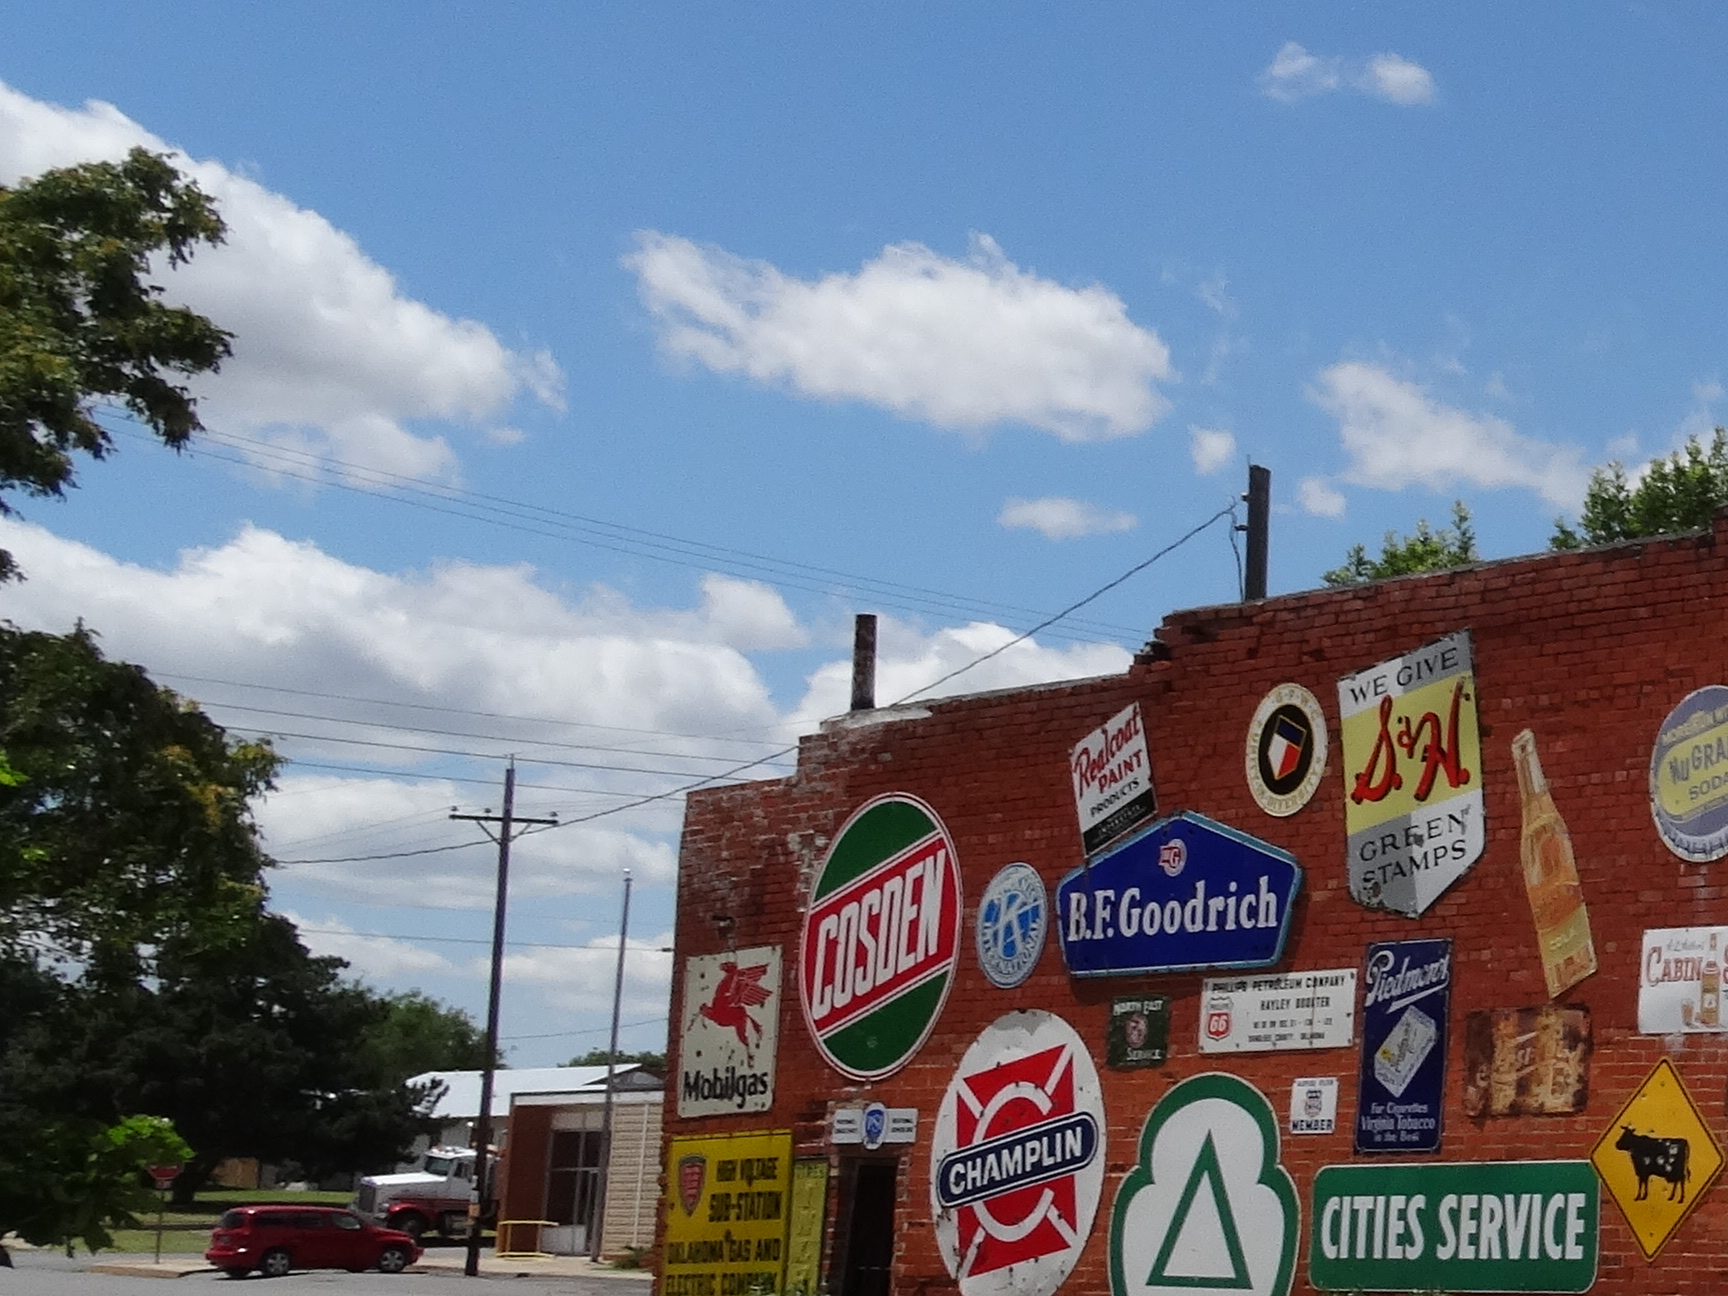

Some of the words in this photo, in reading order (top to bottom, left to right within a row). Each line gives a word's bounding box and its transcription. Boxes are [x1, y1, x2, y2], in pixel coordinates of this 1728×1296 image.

[1349, 674, 1388, 705] WE
[1395, 647, 1459, 687] GIVE
[1097, 748, 1142, 794] PAINT
[1089, 777, 1141, 818] PRODUCTS
[1359, 802, 1472, 863] GREEN
[1361, 838, 1467, 887] STAMPS
[811, 847, 947, 1021] COSDEN
[1253, 977, 1303, 991] PETROLEUM
[1306, 975, 1346, 988] COMPANY
[1364, 950, 1450, 1006] Piedmont
[1645, 945, 1702, 988] CABIN
[1208, 1014, 1229, 1033] 66
[682, 1065, 769, 1109] Mobilgas
[1292, 1119, 1334, 1132] MEMBER
[1396, 1114, 1436, 1131] Tobacco
[716, 1159, 737, 1182] HIGH
[740, 1156, 780, 1181] VOLTAGE
[948, 1126, 1084, 1195] CHAMPLIN
[708, 1190, 783, 1223] SUB-STATION
[1320, 1194, 1426, 1261] CITIES
[1436, 1192, 1586, 1260] SERVICE
[667, 1240, 724, 1265] OKLAHOMA
[728, 1238, 752, 1264] GAS
[755, 1237, 781, 1262] AND
[665, 1273, 716, 1296] ELECTRIC
